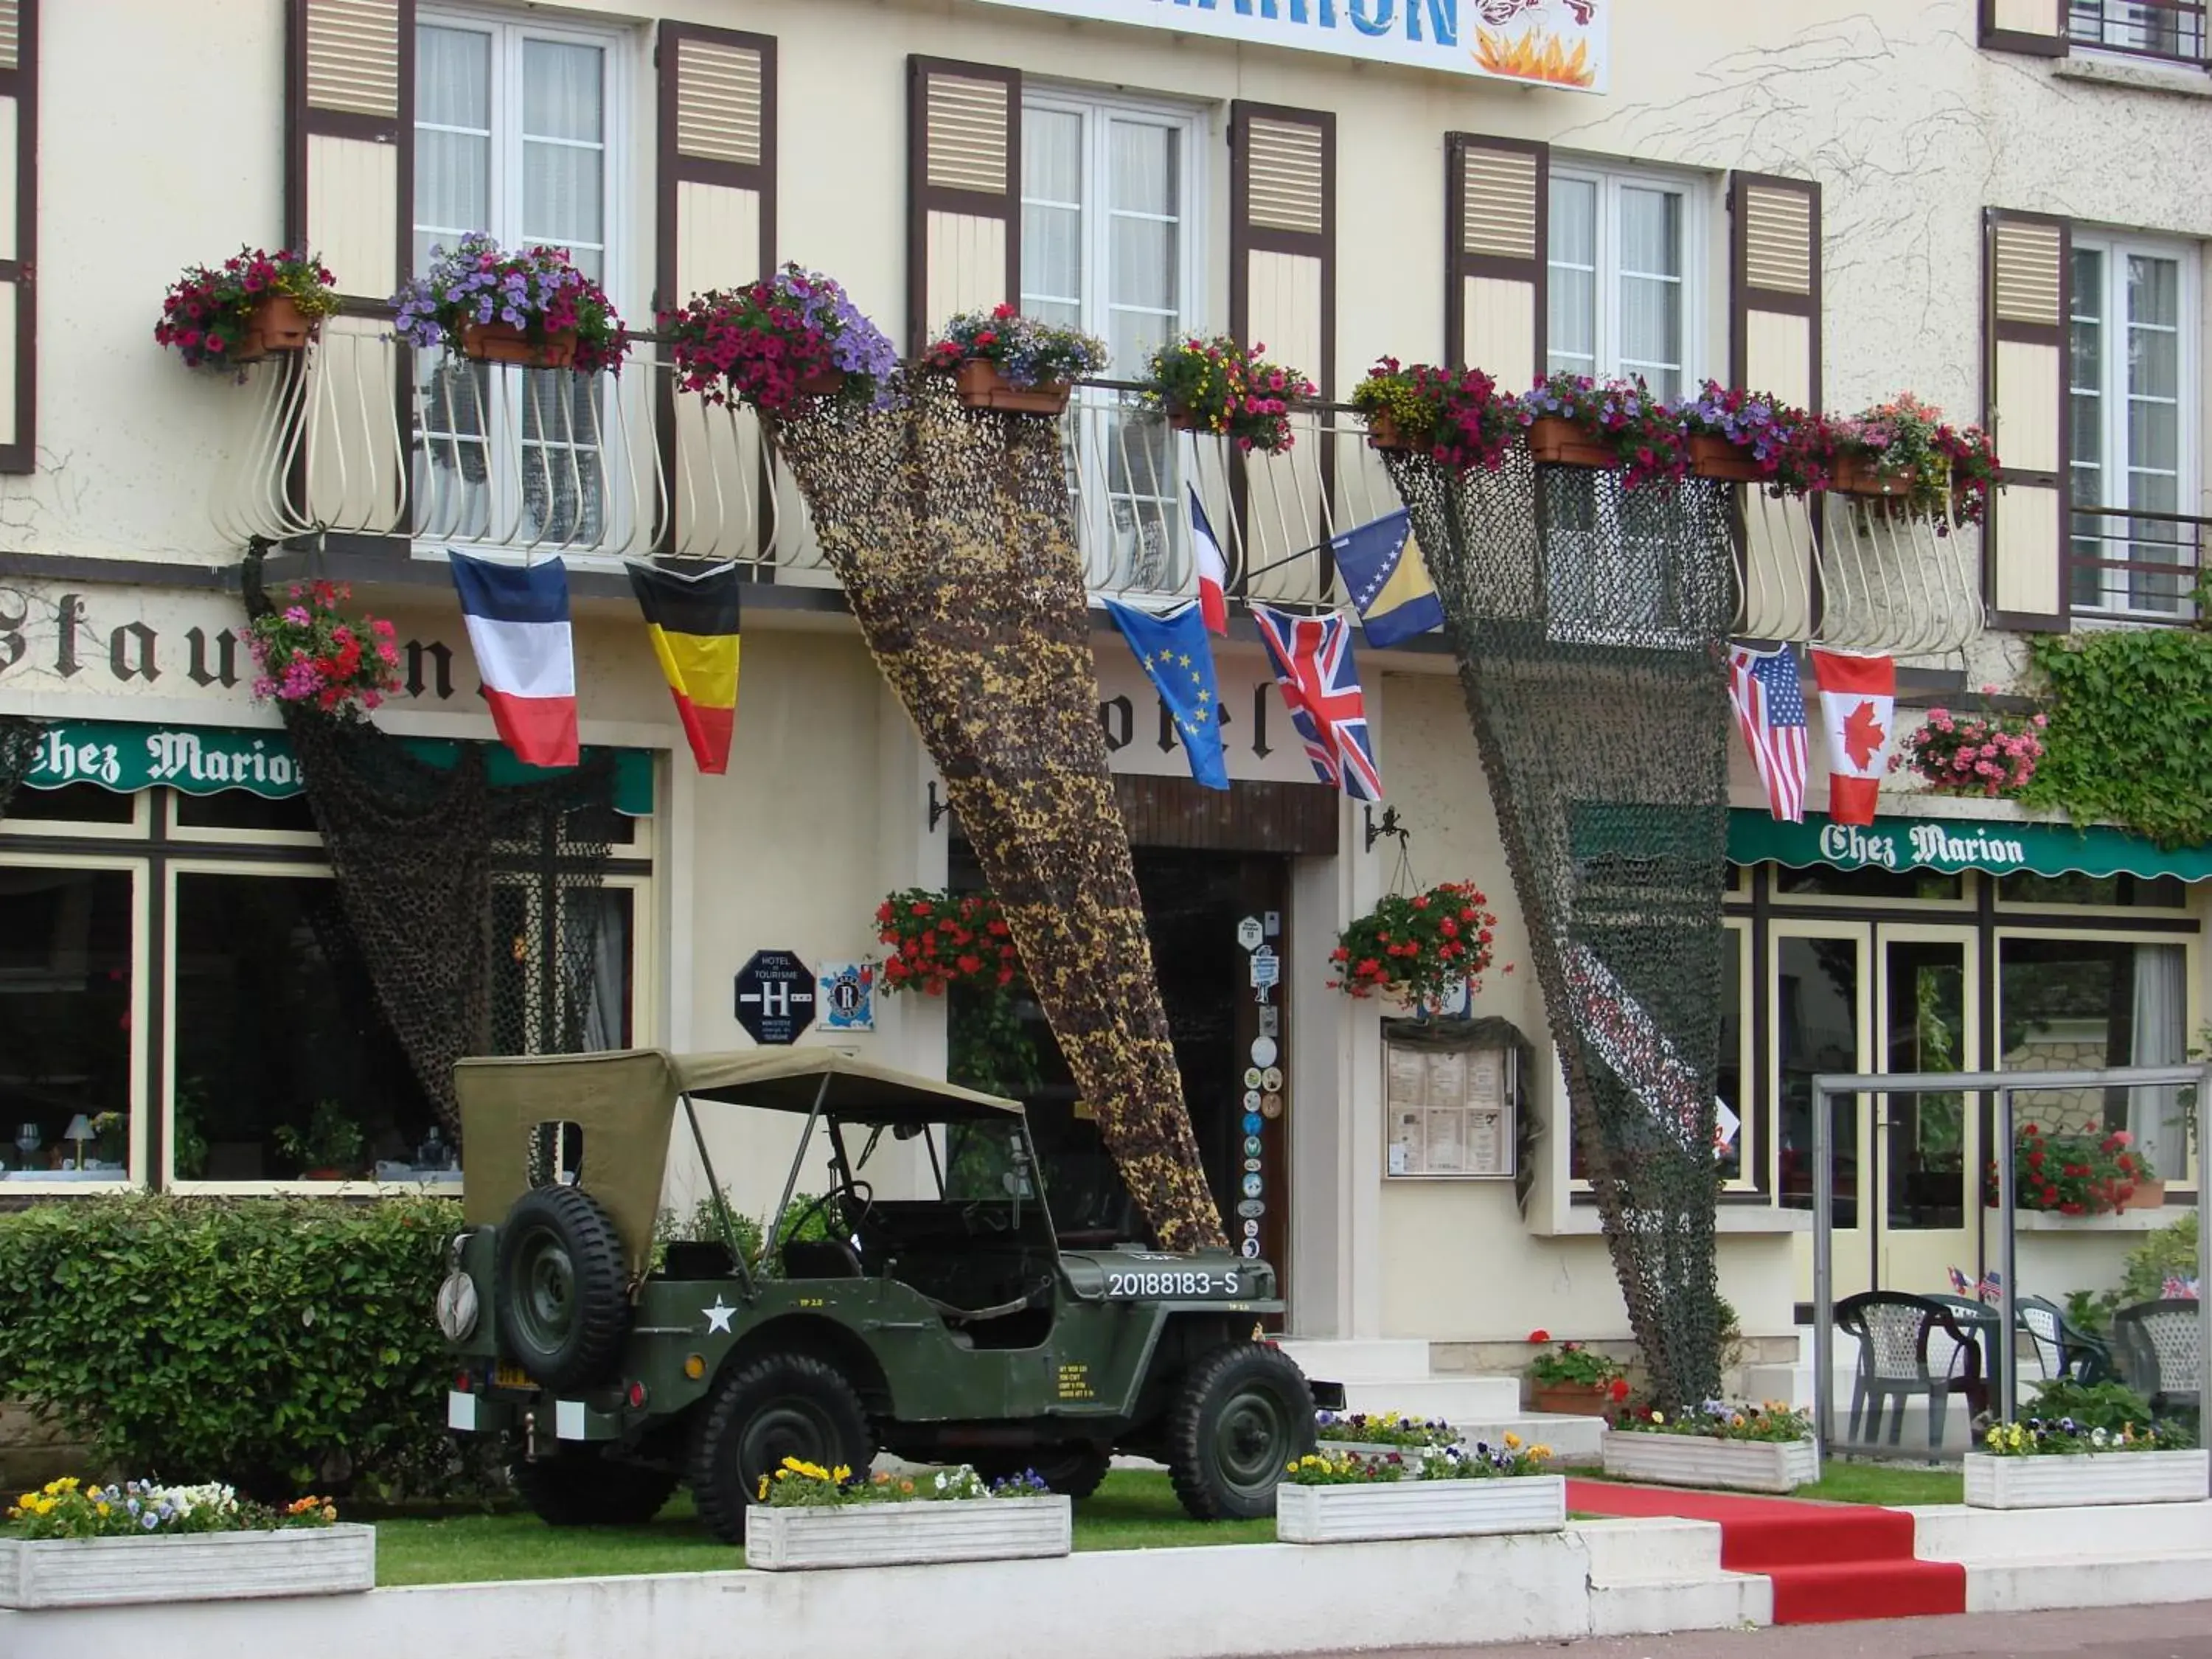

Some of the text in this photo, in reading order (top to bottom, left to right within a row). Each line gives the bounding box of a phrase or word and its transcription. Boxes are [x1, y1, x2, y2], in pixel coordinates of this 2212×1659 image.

[1820, 824, 2025, 868] Chez Marion
[762, 956, 790, 966] HOTEL
[754, 970, 799, 980] TOURISME
[762, 981, 791, 1018] H
[1108, 1271, 1239, 1296] 20188183-S
